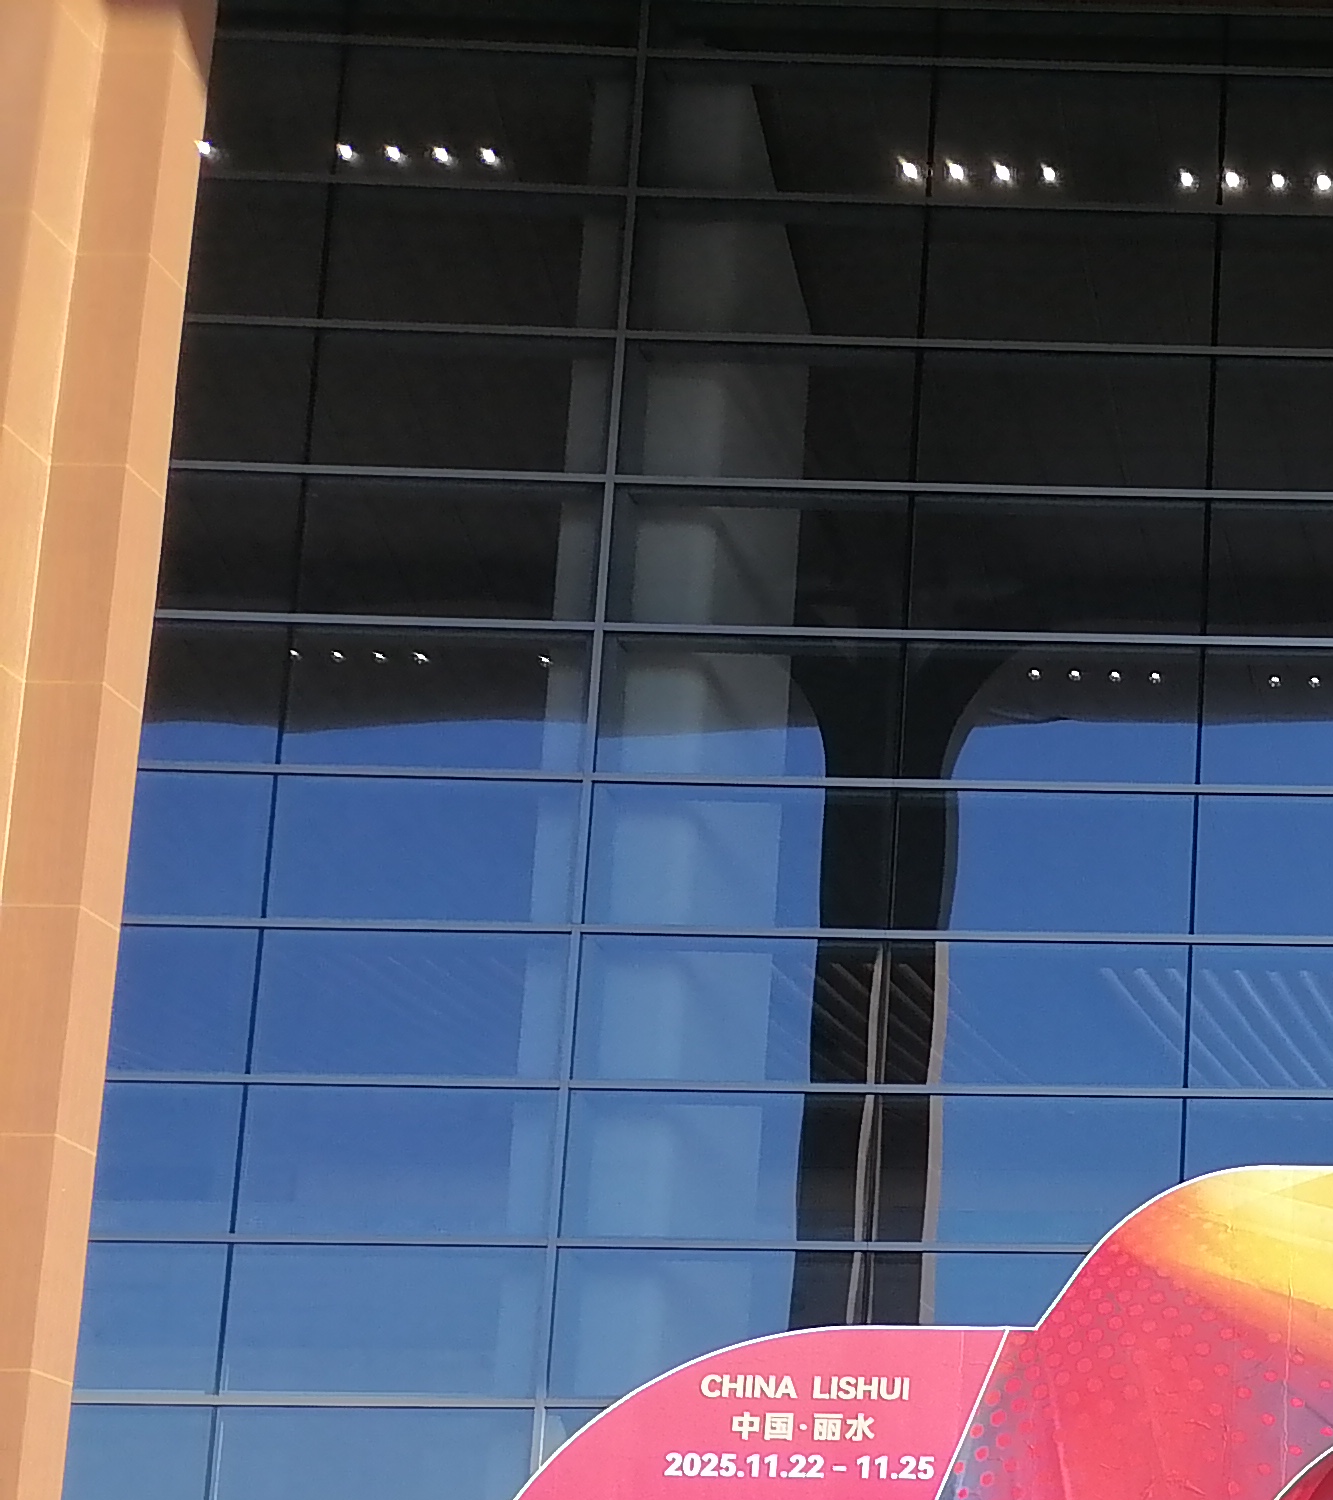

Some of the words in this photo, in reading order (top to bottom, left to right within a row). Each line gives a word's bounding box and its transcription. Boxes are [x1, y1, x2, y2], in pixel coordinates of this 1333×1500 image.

[700, 1374, 798, 1399] CHINA
[812, 1375, 910, 1401] LISHUI
[731, 1411, 875, 1441] 中国·丽水
[663, 1452, 825, 1479] 2025.11.22
[855, 1455, 936, 1480] 11.25
